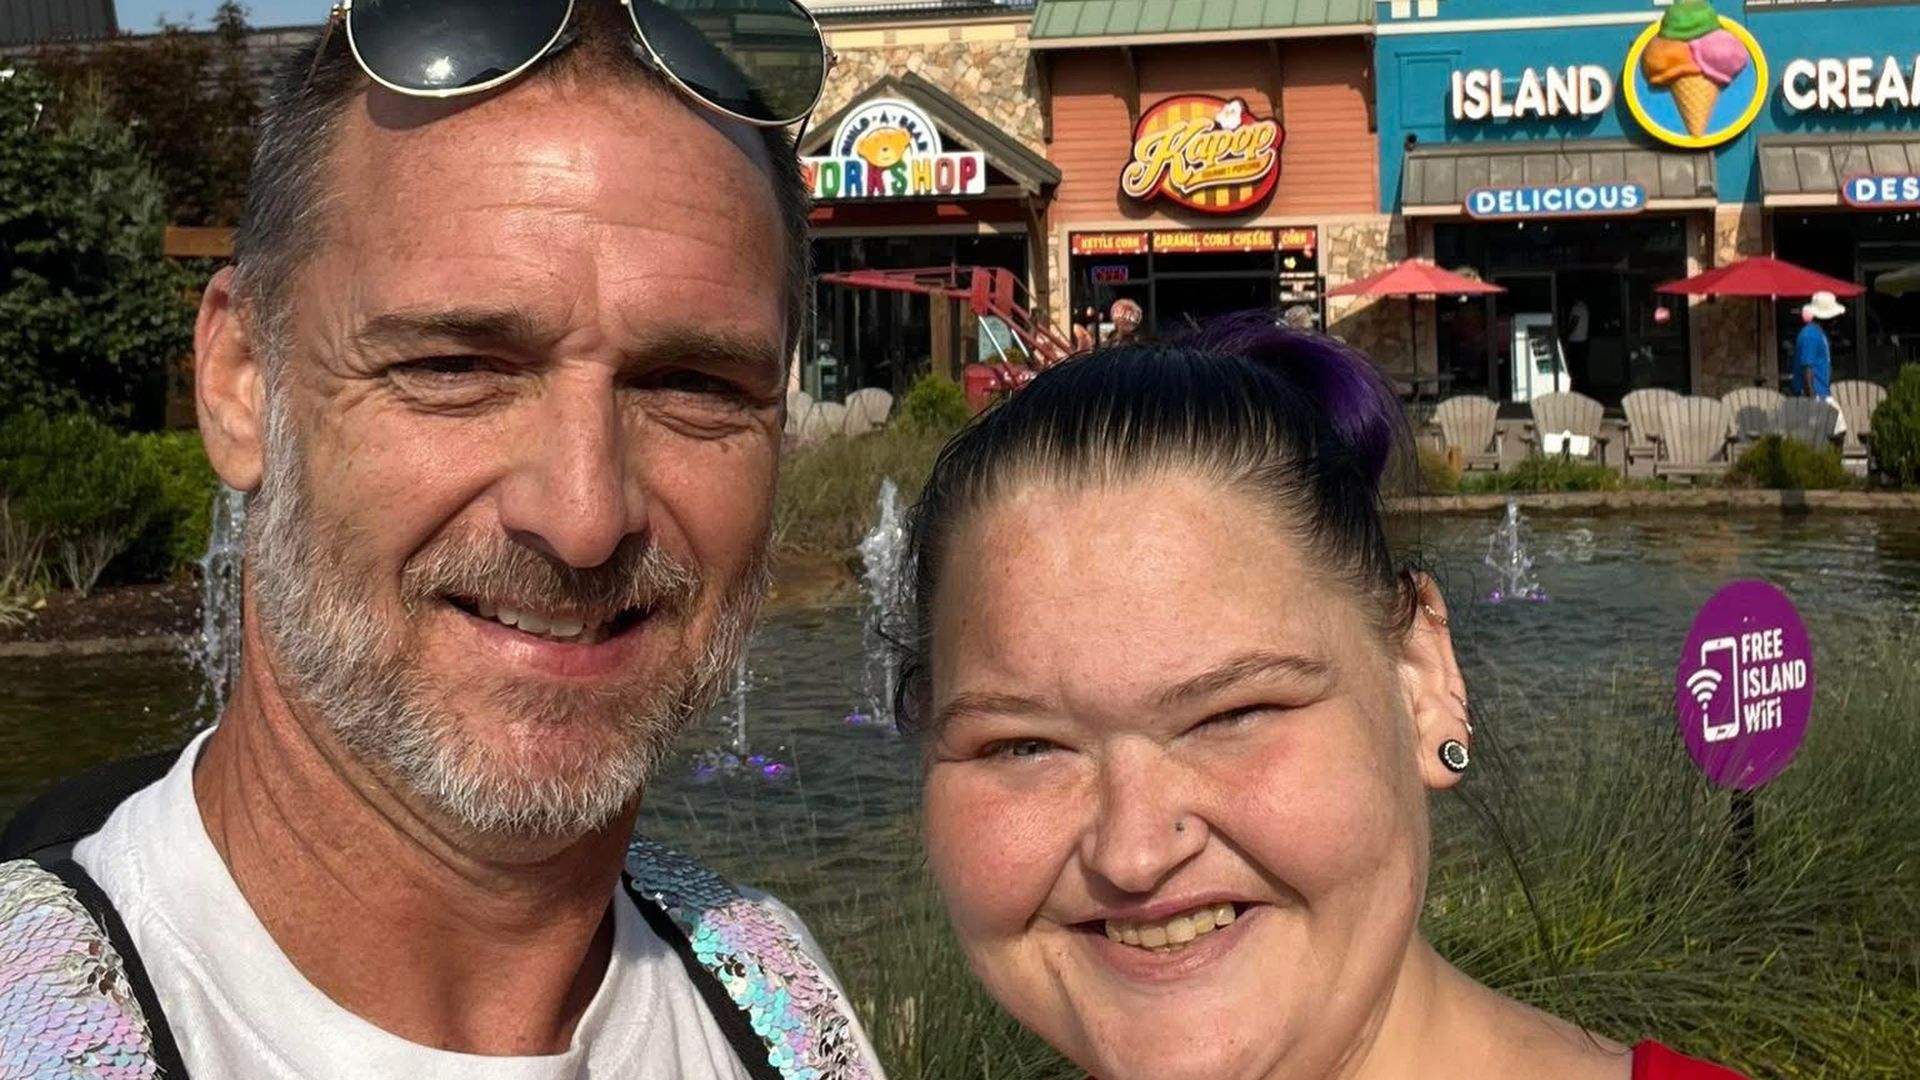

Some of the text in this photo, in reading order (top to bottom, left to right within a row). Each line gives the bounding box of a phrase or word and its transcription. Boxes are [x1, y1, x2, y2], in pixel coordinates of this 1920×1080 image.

[1452, 64, 1613, 120] ISLAND
[1123, 117, 1279, 196] Kapop
[1476, 185, 1638, 213] DELICIOUS
[1855, 177, 1920, 200] DES
[1080, 236, 1140, 249] KETTLE CORN
[1153, 230, 1273, 247] CARAMEL CORN CHEESE
[1281, 230, 1306, 245] CORN
[1741, 628, 1783, 664] FREE
[1743, 659, 1807, 699] ISLAND
[1743, 697, 1782, 734] WiFi
